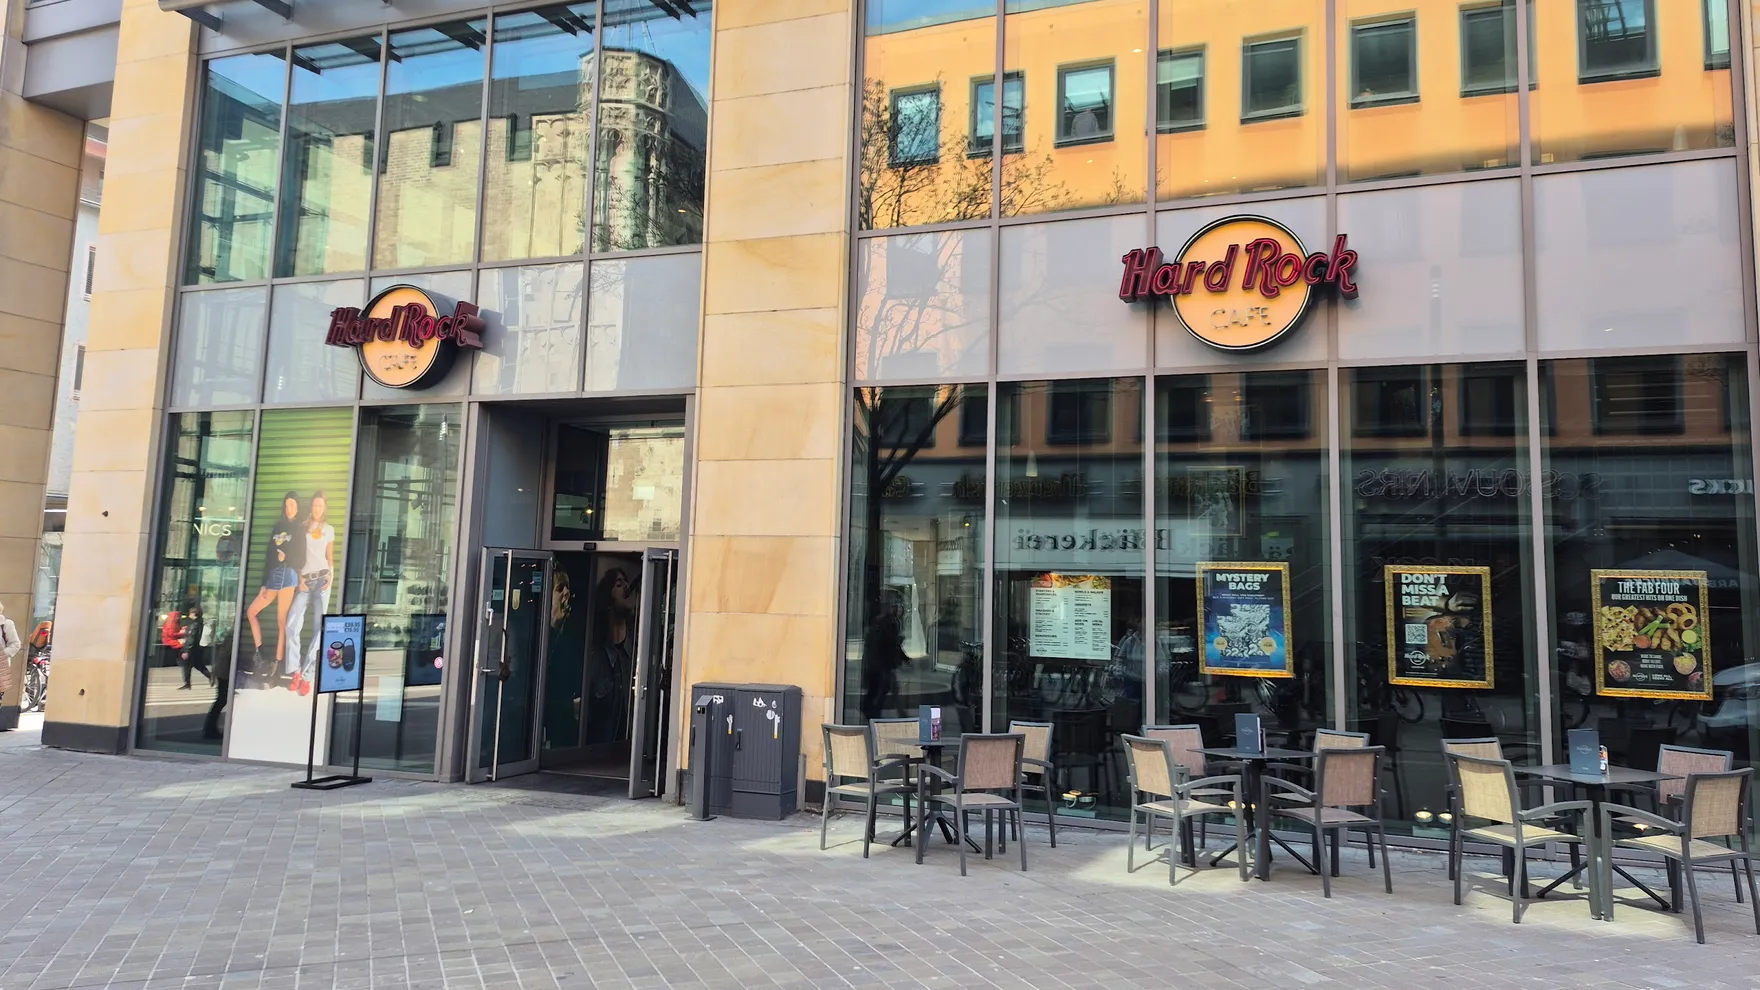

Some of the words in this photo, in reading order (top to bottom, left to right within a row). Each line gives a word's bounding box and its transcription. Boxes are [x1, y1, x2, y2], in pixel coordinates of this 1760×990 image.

[1119, 244, 1239, 303] Hard
[1242, 234, 1359, 299] Rock
[1210, 306, 1271, 329] CAFE
[325, 305, 400, 348] Hard
[399, 301, 485, 349] Rock
[1216, 573, 1269, 582] MYSTERY
[1401, 574, 1447, 583] DON'T
[1228, 582, 1260, 591] BAGS
[1401, 584, 1436, 595] MISS
[1438, 585, 1450, 595] A
[1617, 581, 1635, 593] THE
[1636, 581, 1654, 594] FAB
[1655, 582, 1680, 594] FOUR
[1402, 595, 1439, 606] BEAT
